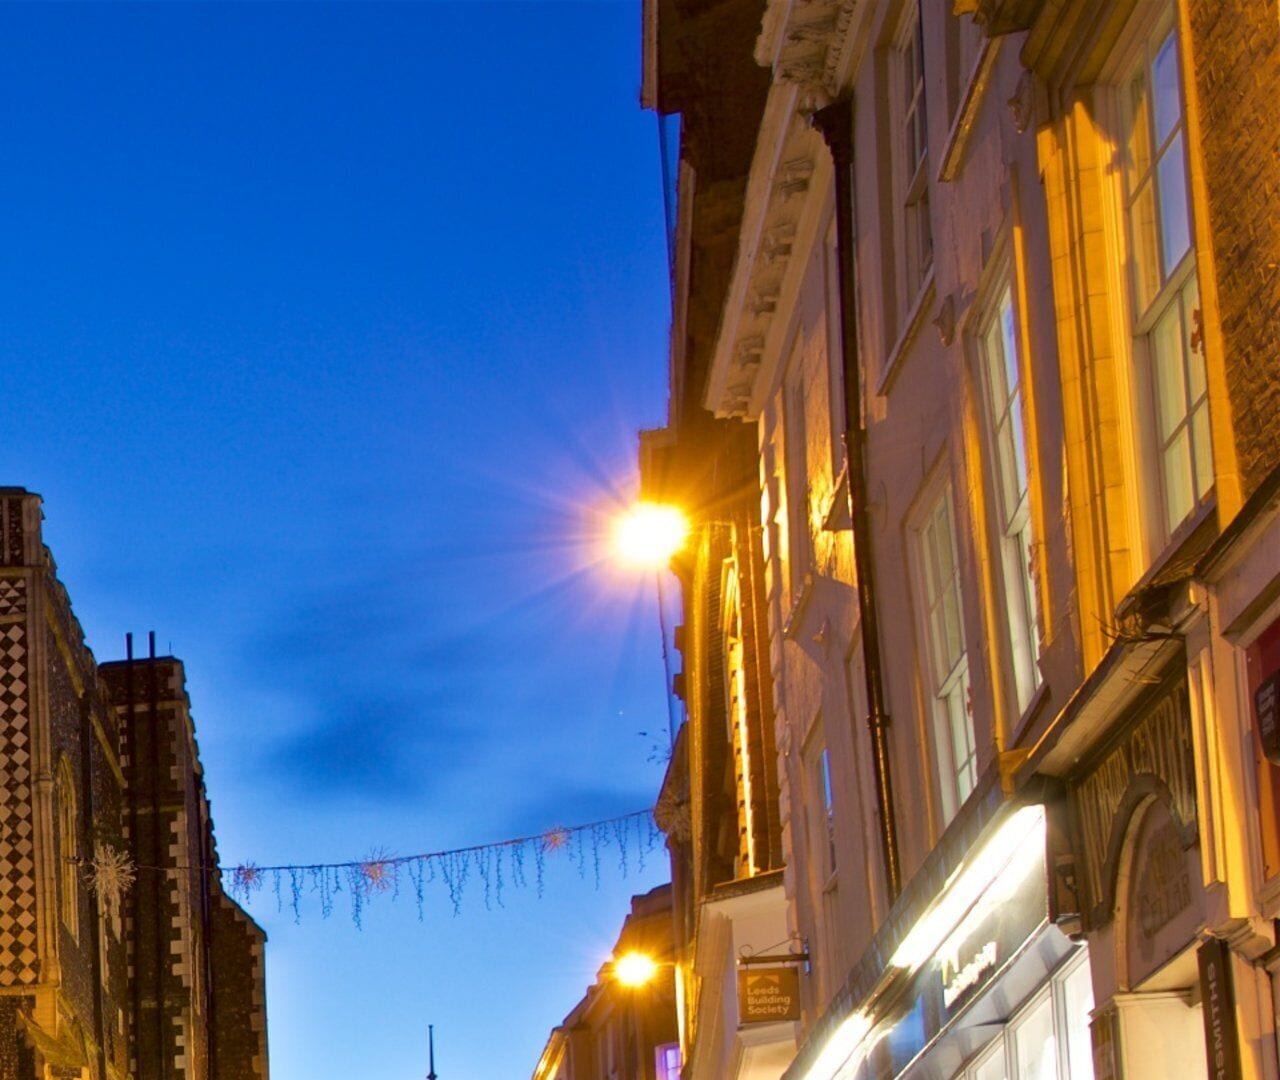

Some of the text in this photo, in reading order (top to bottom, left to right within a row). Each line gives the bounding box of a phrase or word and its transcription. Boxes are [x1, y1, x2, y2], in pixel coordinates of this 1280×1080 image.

[747, 986, 780, 996] Leeds
[747, 995, 791, 1006] Building
[747, 1005, 790, 1016] Society
